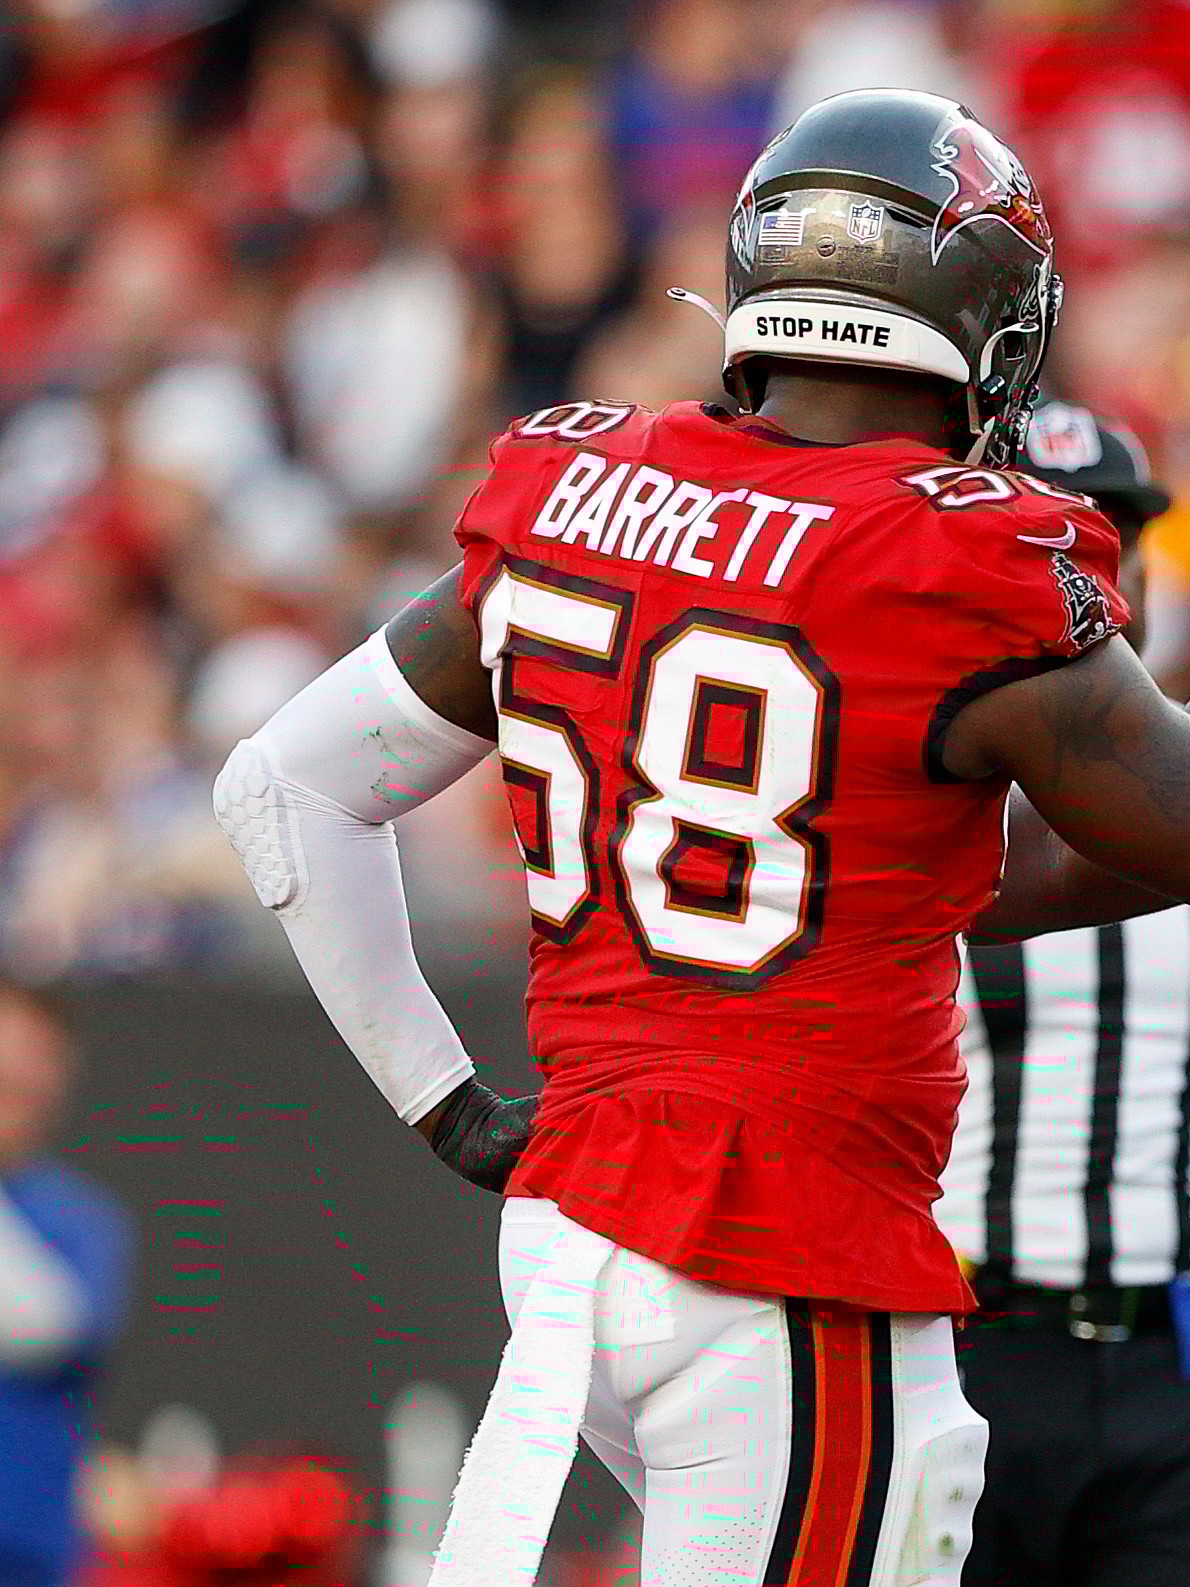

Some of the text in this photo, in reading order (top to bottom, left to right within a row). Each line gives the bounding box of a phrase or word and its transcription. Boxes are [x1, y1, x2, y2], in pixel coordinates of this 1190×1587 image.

[851, 218, 876, 236] NFL
[756, 316, 891, 348] STOP HATE
[530, 451, 835, 587] BARRETT
[475, 556, 841, 990] 58
